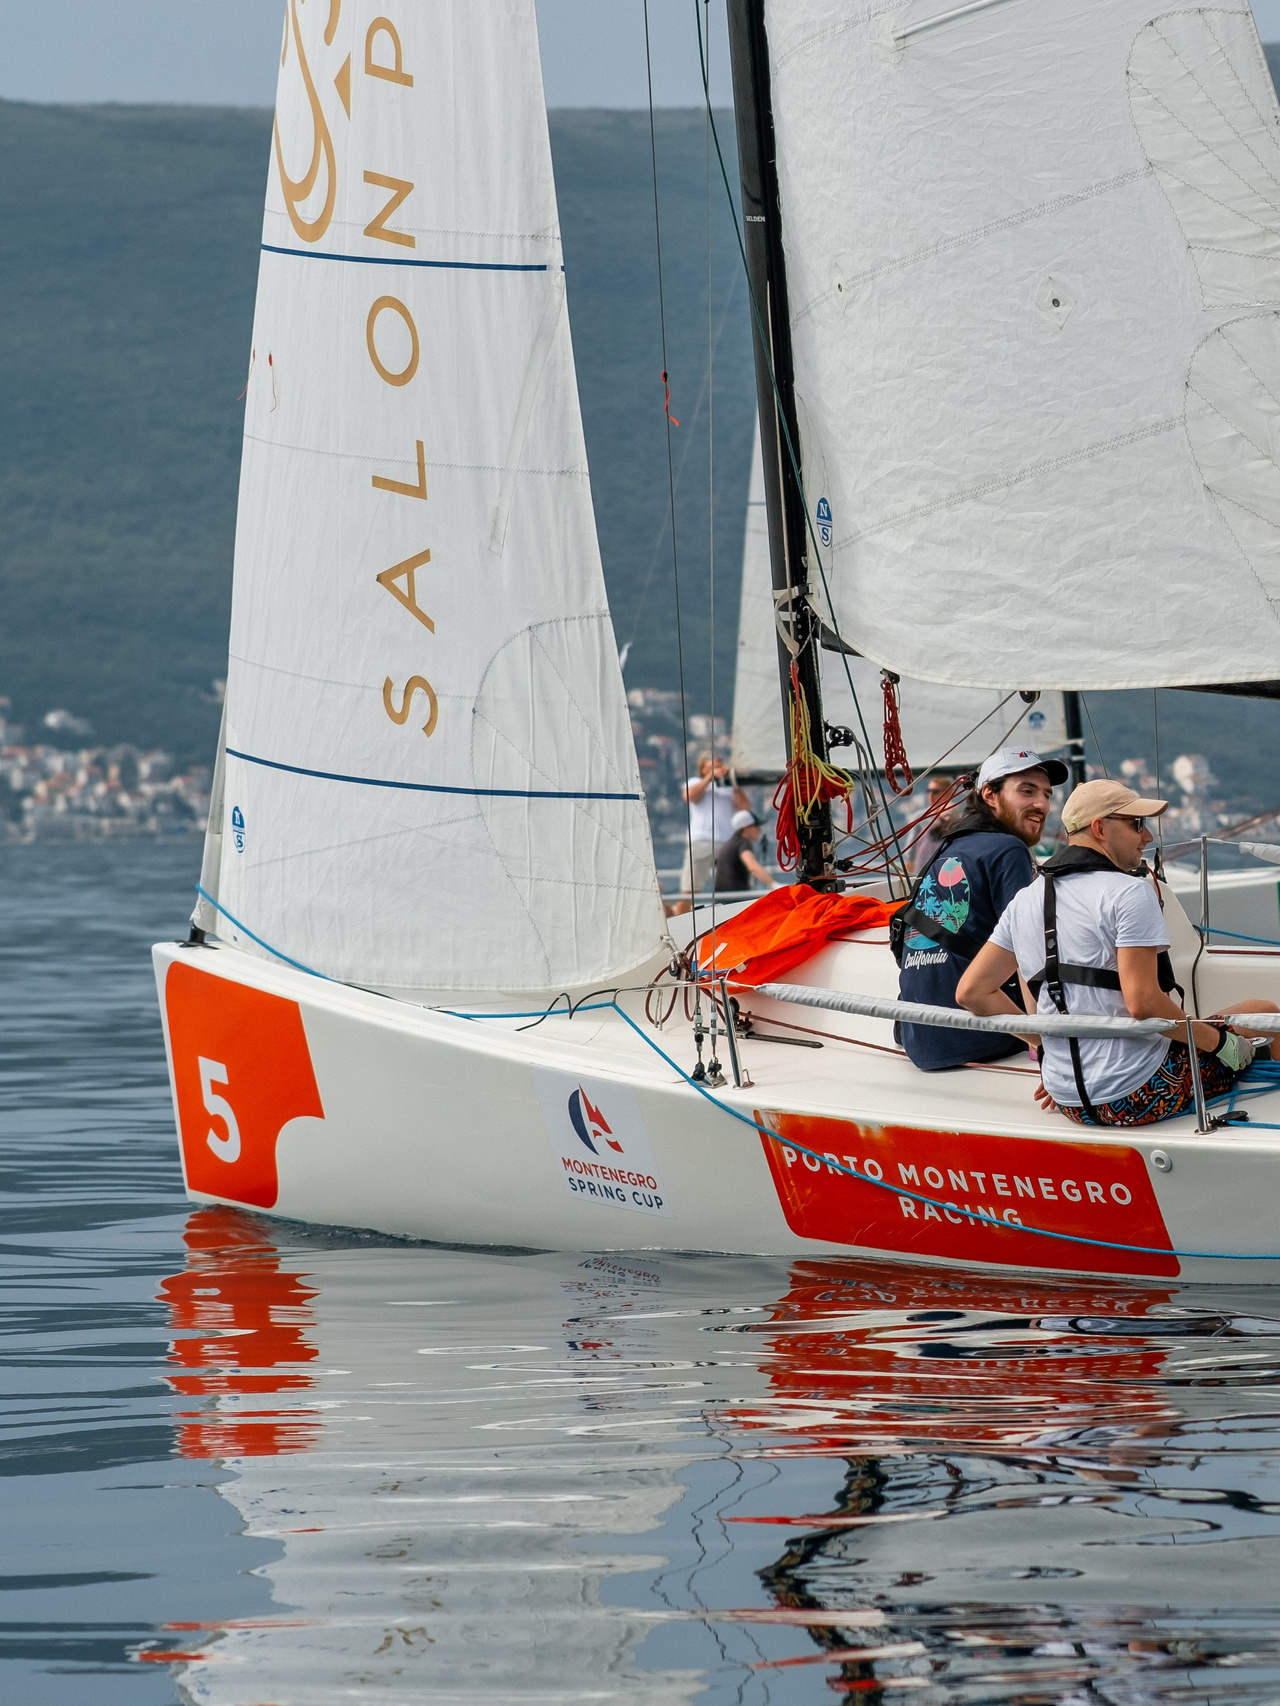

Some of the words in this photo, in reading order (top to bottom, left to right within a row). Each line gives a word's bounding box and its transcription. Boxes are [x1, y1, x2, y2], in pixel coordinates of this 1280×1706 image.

[363, 170, 439, 738] SALON
[198, 1055, 242, 1163] 5
[562, 1156, 658, 1190] MONTENEGRO
[568, 1177, 627, 1203] SPRING
[632, 1191, 664, 1210] CUP
[782, 1146, 883, 1181] PORTO
[897, 1162, 1132, 1206] MONTENEGRO
[898, 1196, 1024, 1230] RACING
